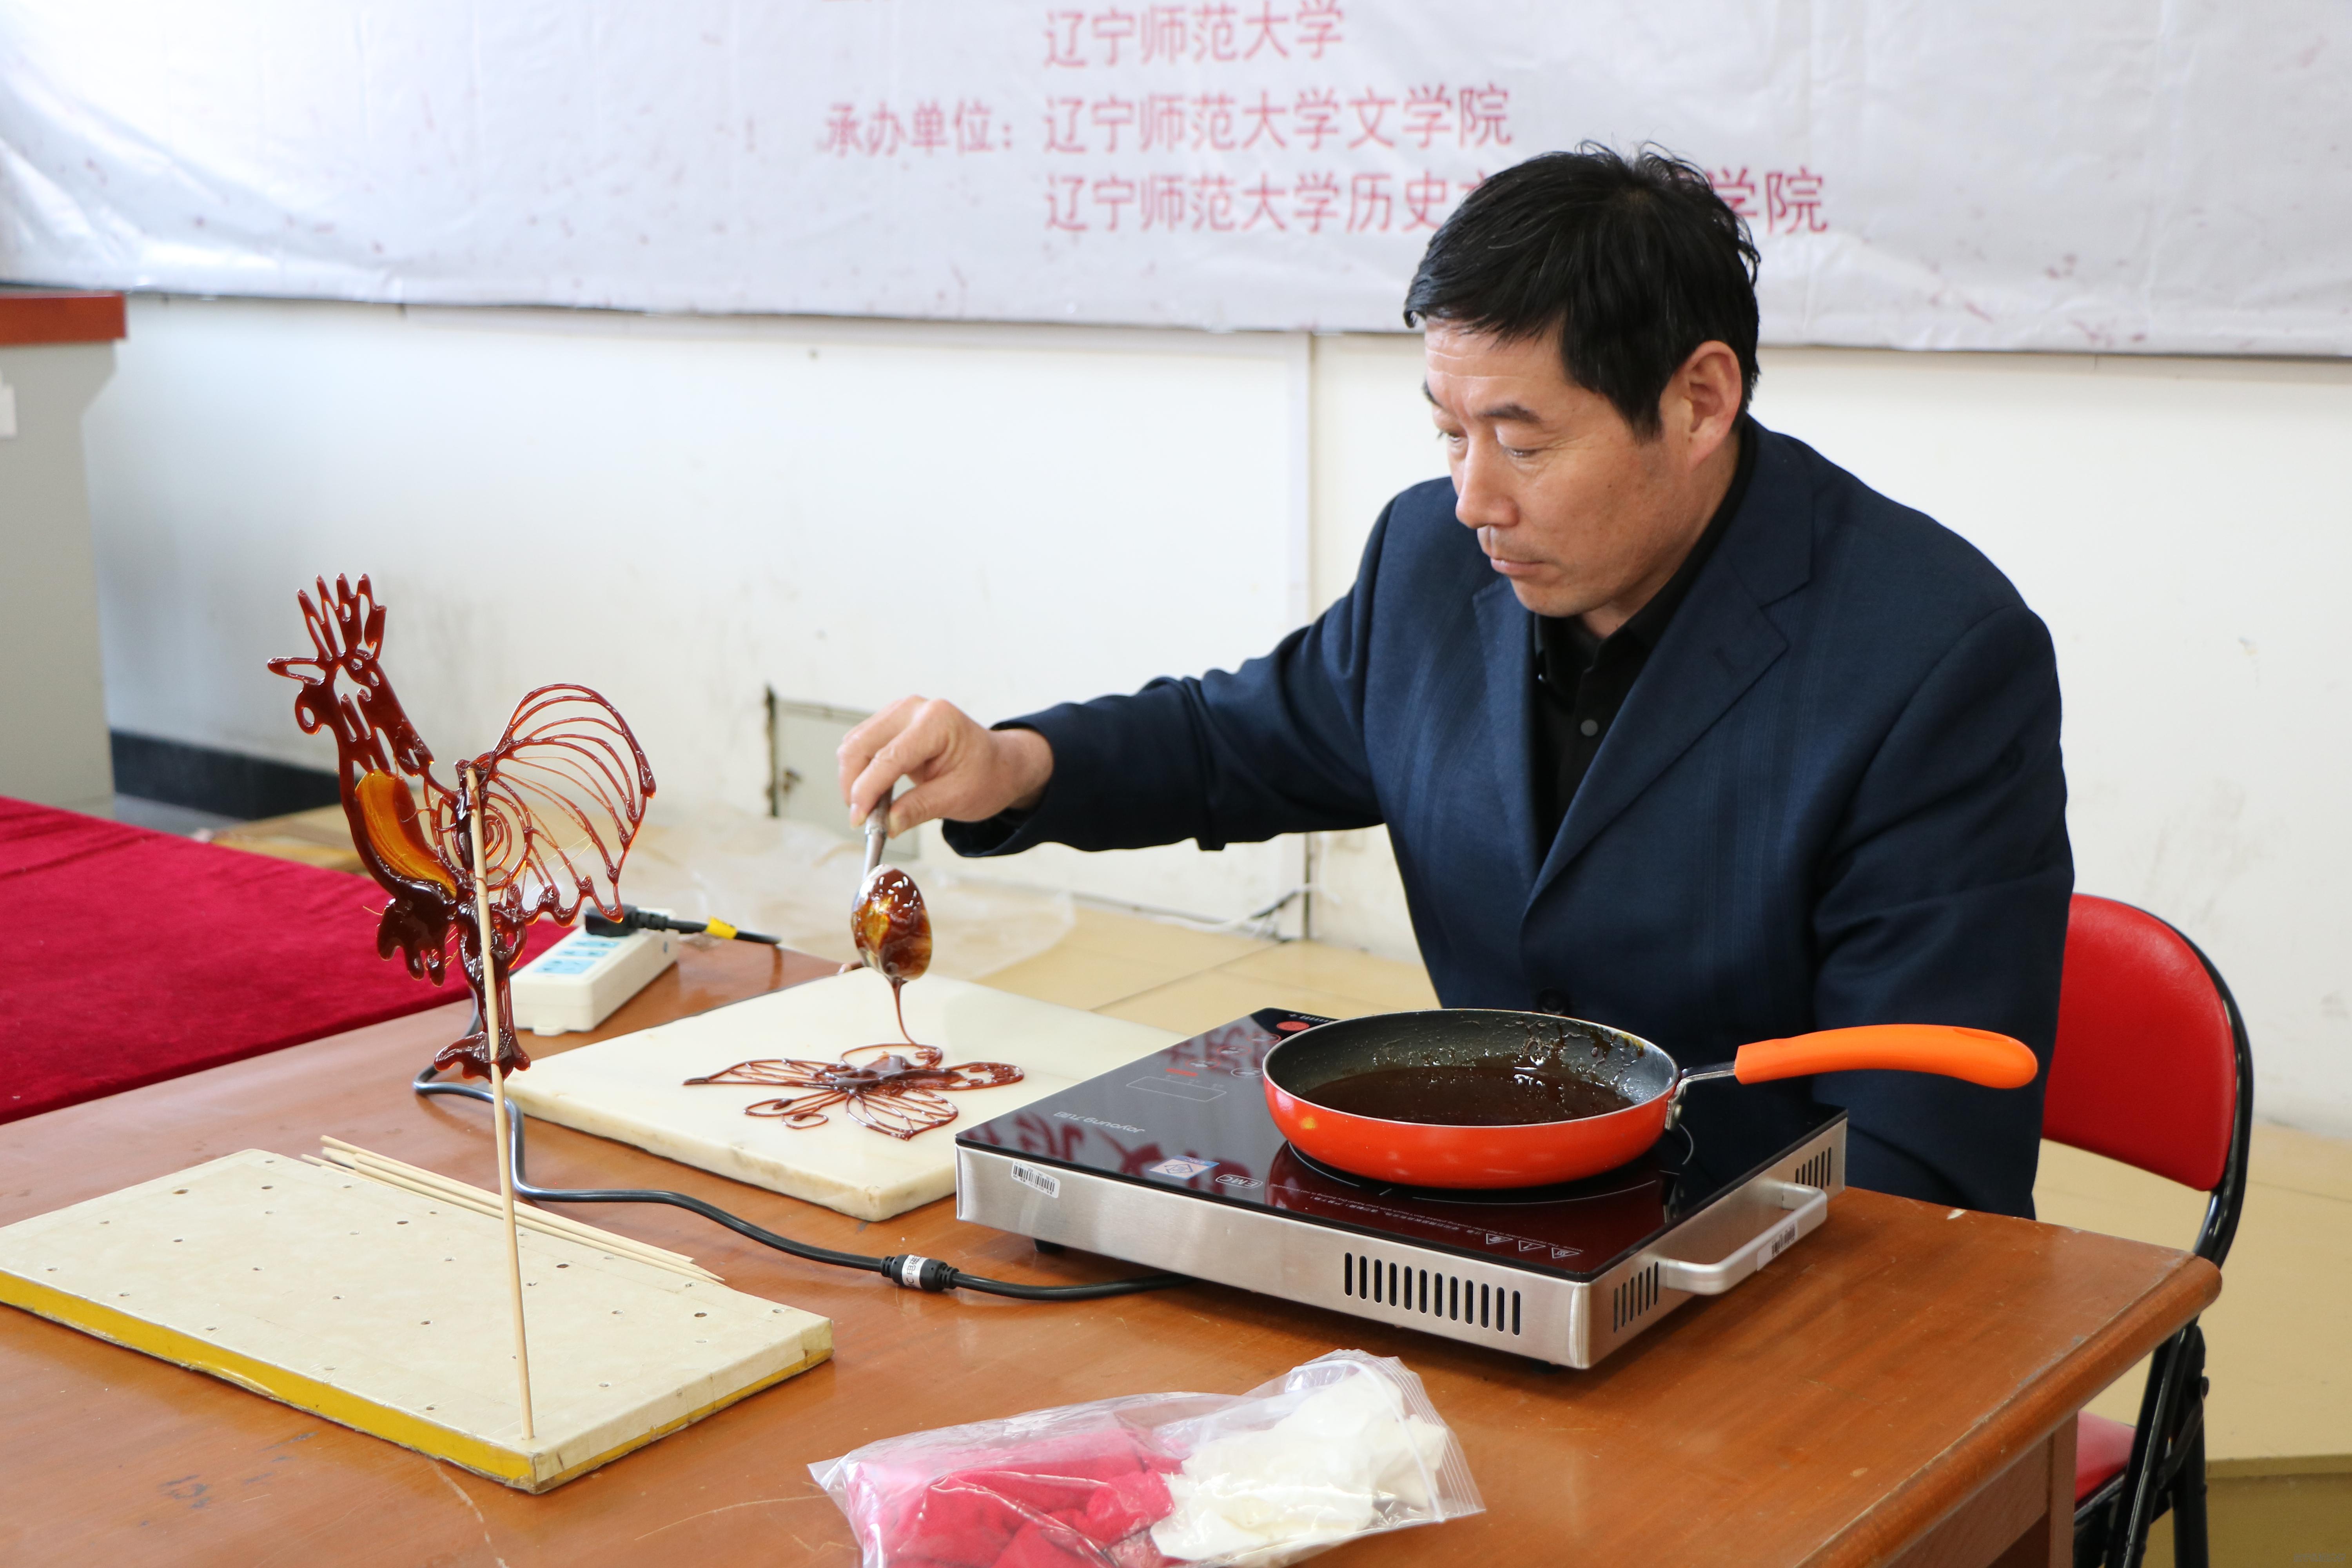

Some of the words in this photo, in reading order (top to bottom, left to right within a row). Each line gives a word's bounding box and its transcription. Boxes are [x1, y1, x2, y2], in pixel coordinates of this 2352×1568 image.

[1044, 0, 1344, 67] 辽宁师范大学
[1044, 82, 1512, 153] 辽宁师范大学文学院
[1083, 1117, 1145, 1133] Joyoung
[1219, 1176, 1258, 1188] EMC
